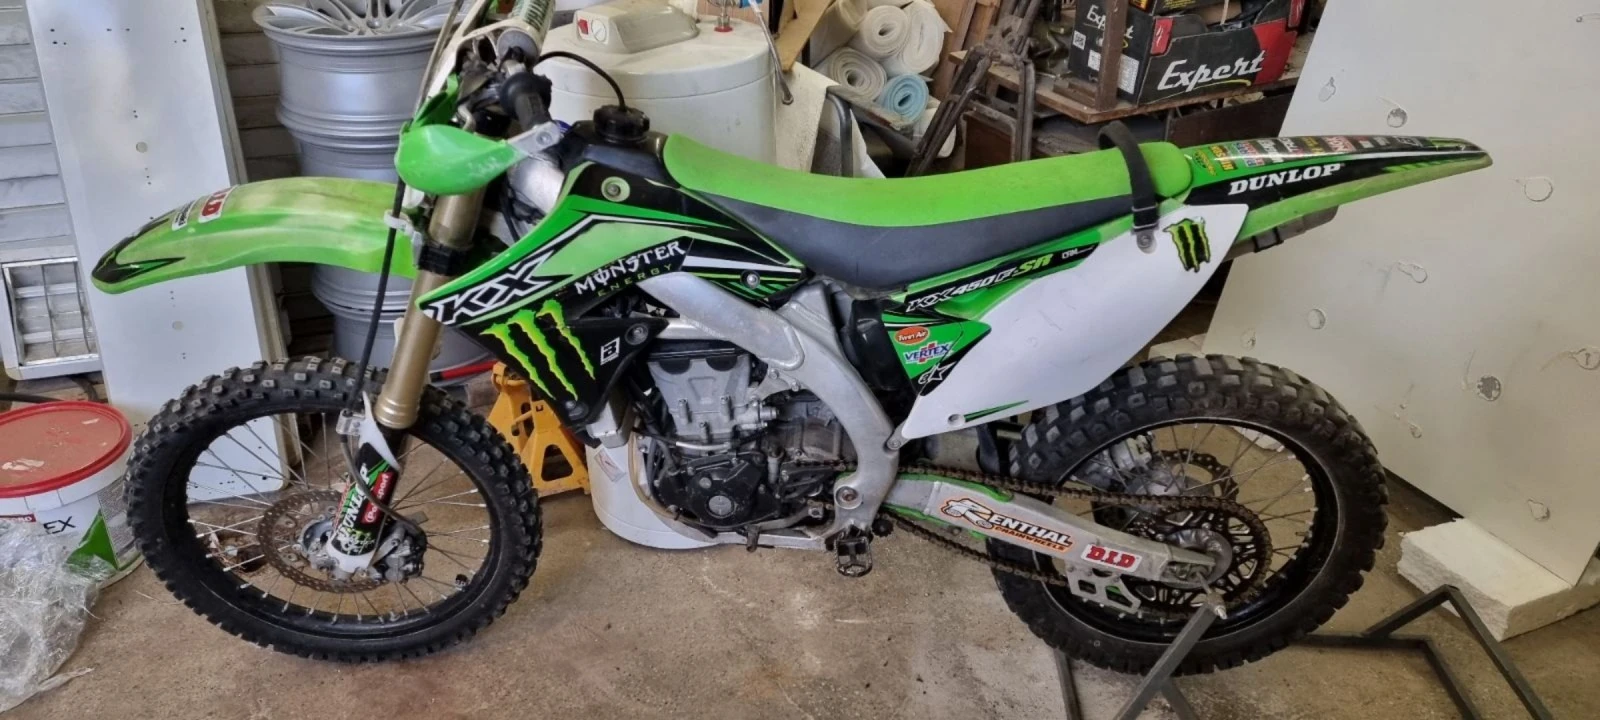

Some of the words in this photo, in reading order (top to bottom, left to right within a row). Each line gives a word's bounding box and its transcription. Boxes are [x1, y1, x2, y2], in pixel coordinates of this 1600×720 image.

[1086, 4, 1134, 40] Expt
[1157, 50, 1265, 93] Expert
[1228, 163, 1341, 195] DUNLOP
[574, 241, 686, 295] MONSTER
[598, 263, 673, 297] ENERGY
[421, 250, 573, 326] KX
[898, 333, 915, 342] Twin
[916, 331, 927, 339] Air
[905, 343, 950, 361] VERTEX
[365, 472, 391, 523] Posport
[994, 526, 1066, 551] CHAINWHEELS
[1086, 545, 1136, 569] D.I.D
